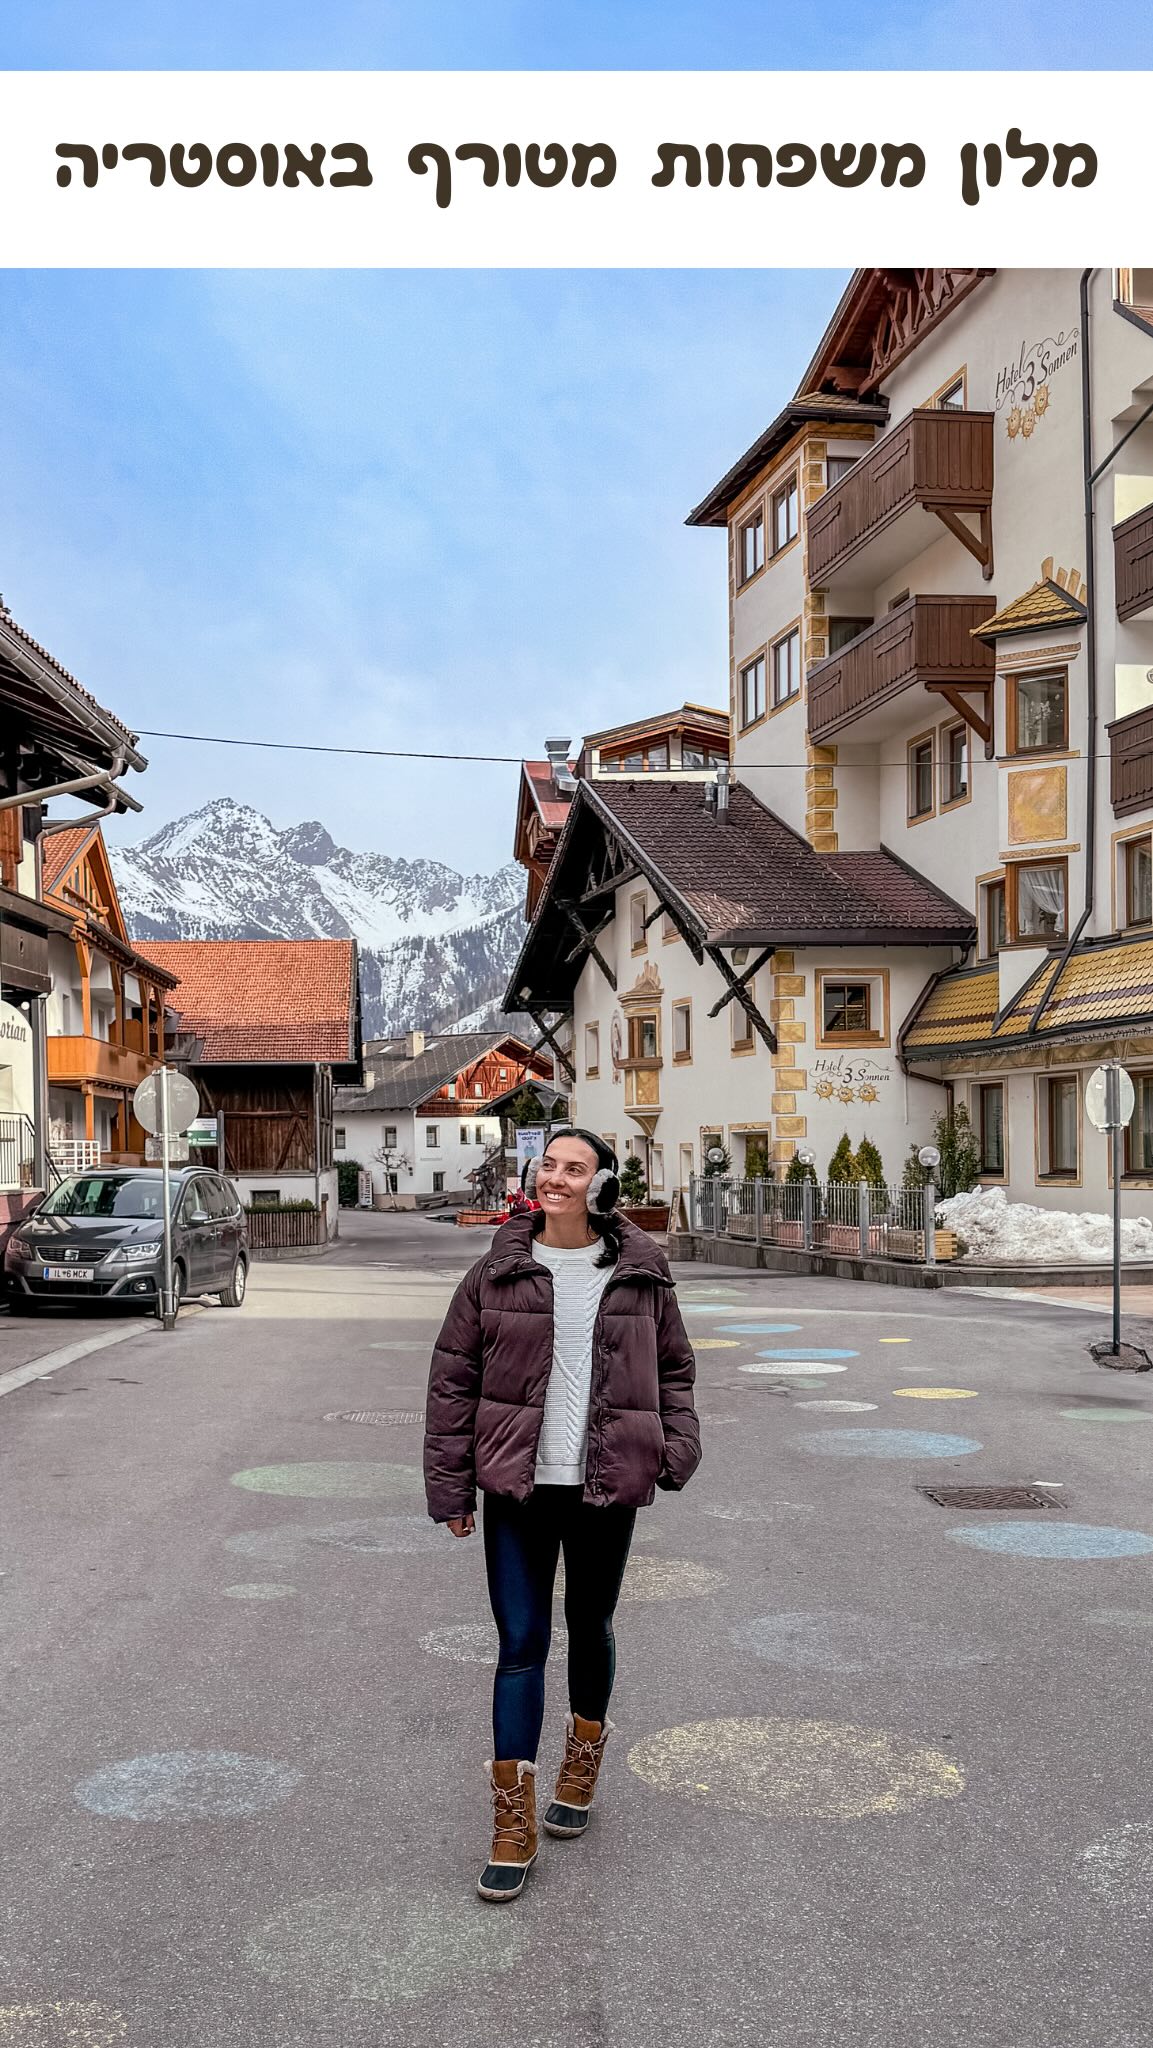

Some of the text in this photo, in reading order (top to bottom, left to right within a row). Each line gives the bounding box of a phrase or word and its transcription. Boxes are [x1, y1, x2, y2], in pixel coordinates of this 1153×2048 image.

[995, 340, 1078, 401] Hotel 3 Sonnen
[0, 1015, 27, 1043] orian
[814, 1054, 890, 1084] Hotel 3 Sonnen
